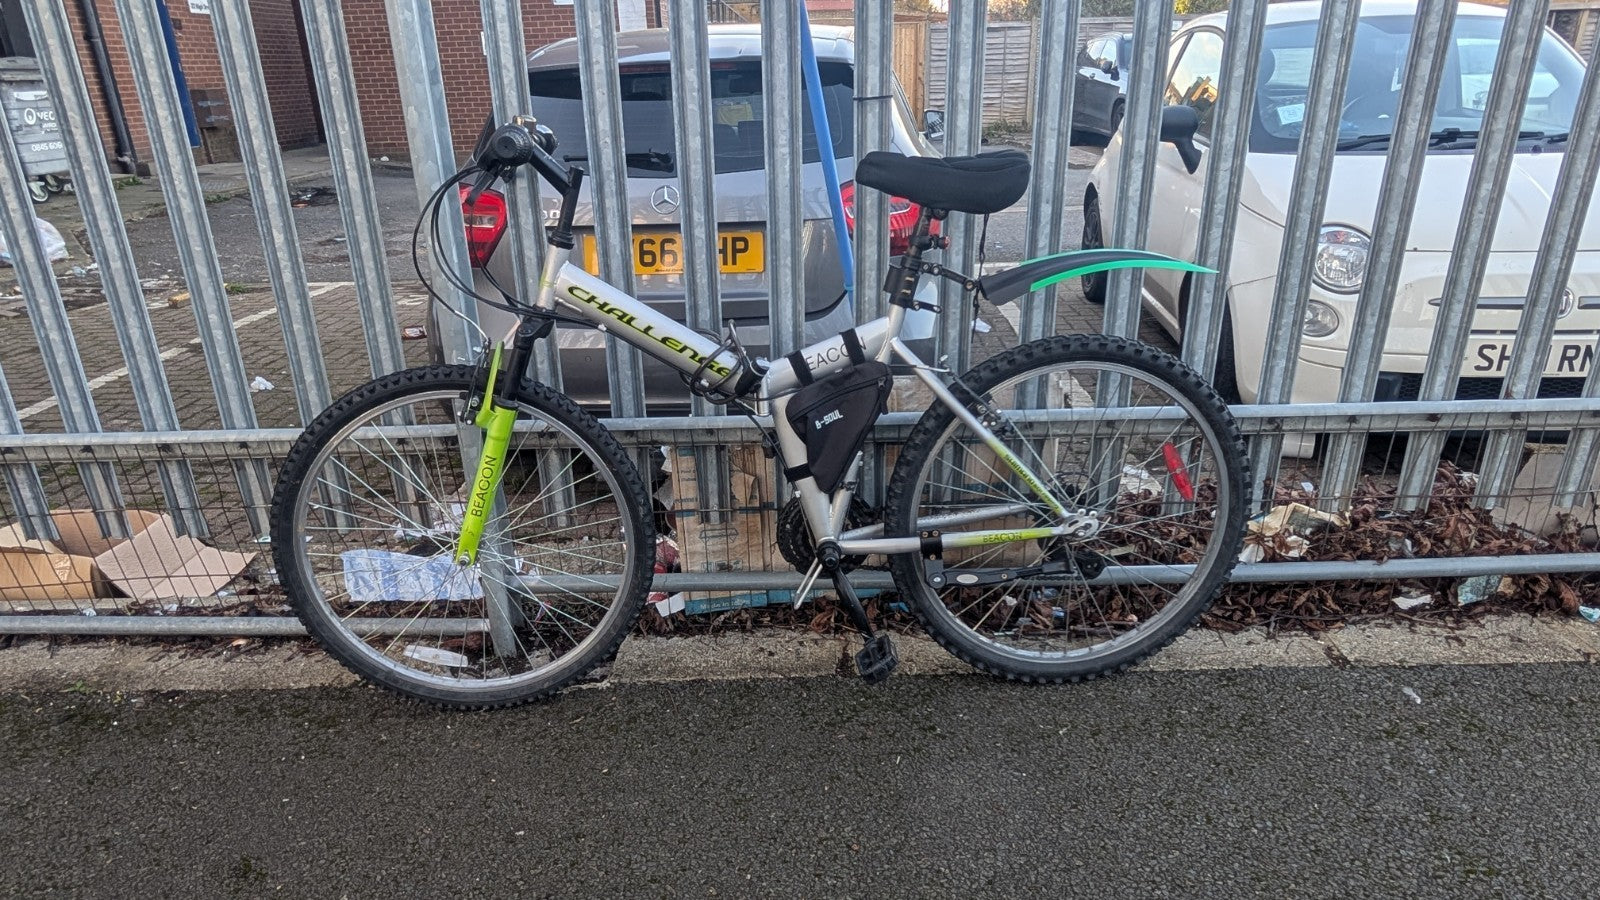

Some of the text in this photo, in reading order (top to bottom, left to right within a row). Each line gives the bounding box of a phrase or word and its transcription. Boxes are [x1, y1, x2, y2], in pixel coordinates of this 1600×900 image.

[633, 236, 749, 268] 66 HP
[567, 285, 732, 378] CHALLENGE
[1557, 344, 1594, 372] RN
[814, 409, 843, 430] B-SOUL
[471, 454, 497, 517] BEACON
[983, 531, 1022, 543] BEACON
